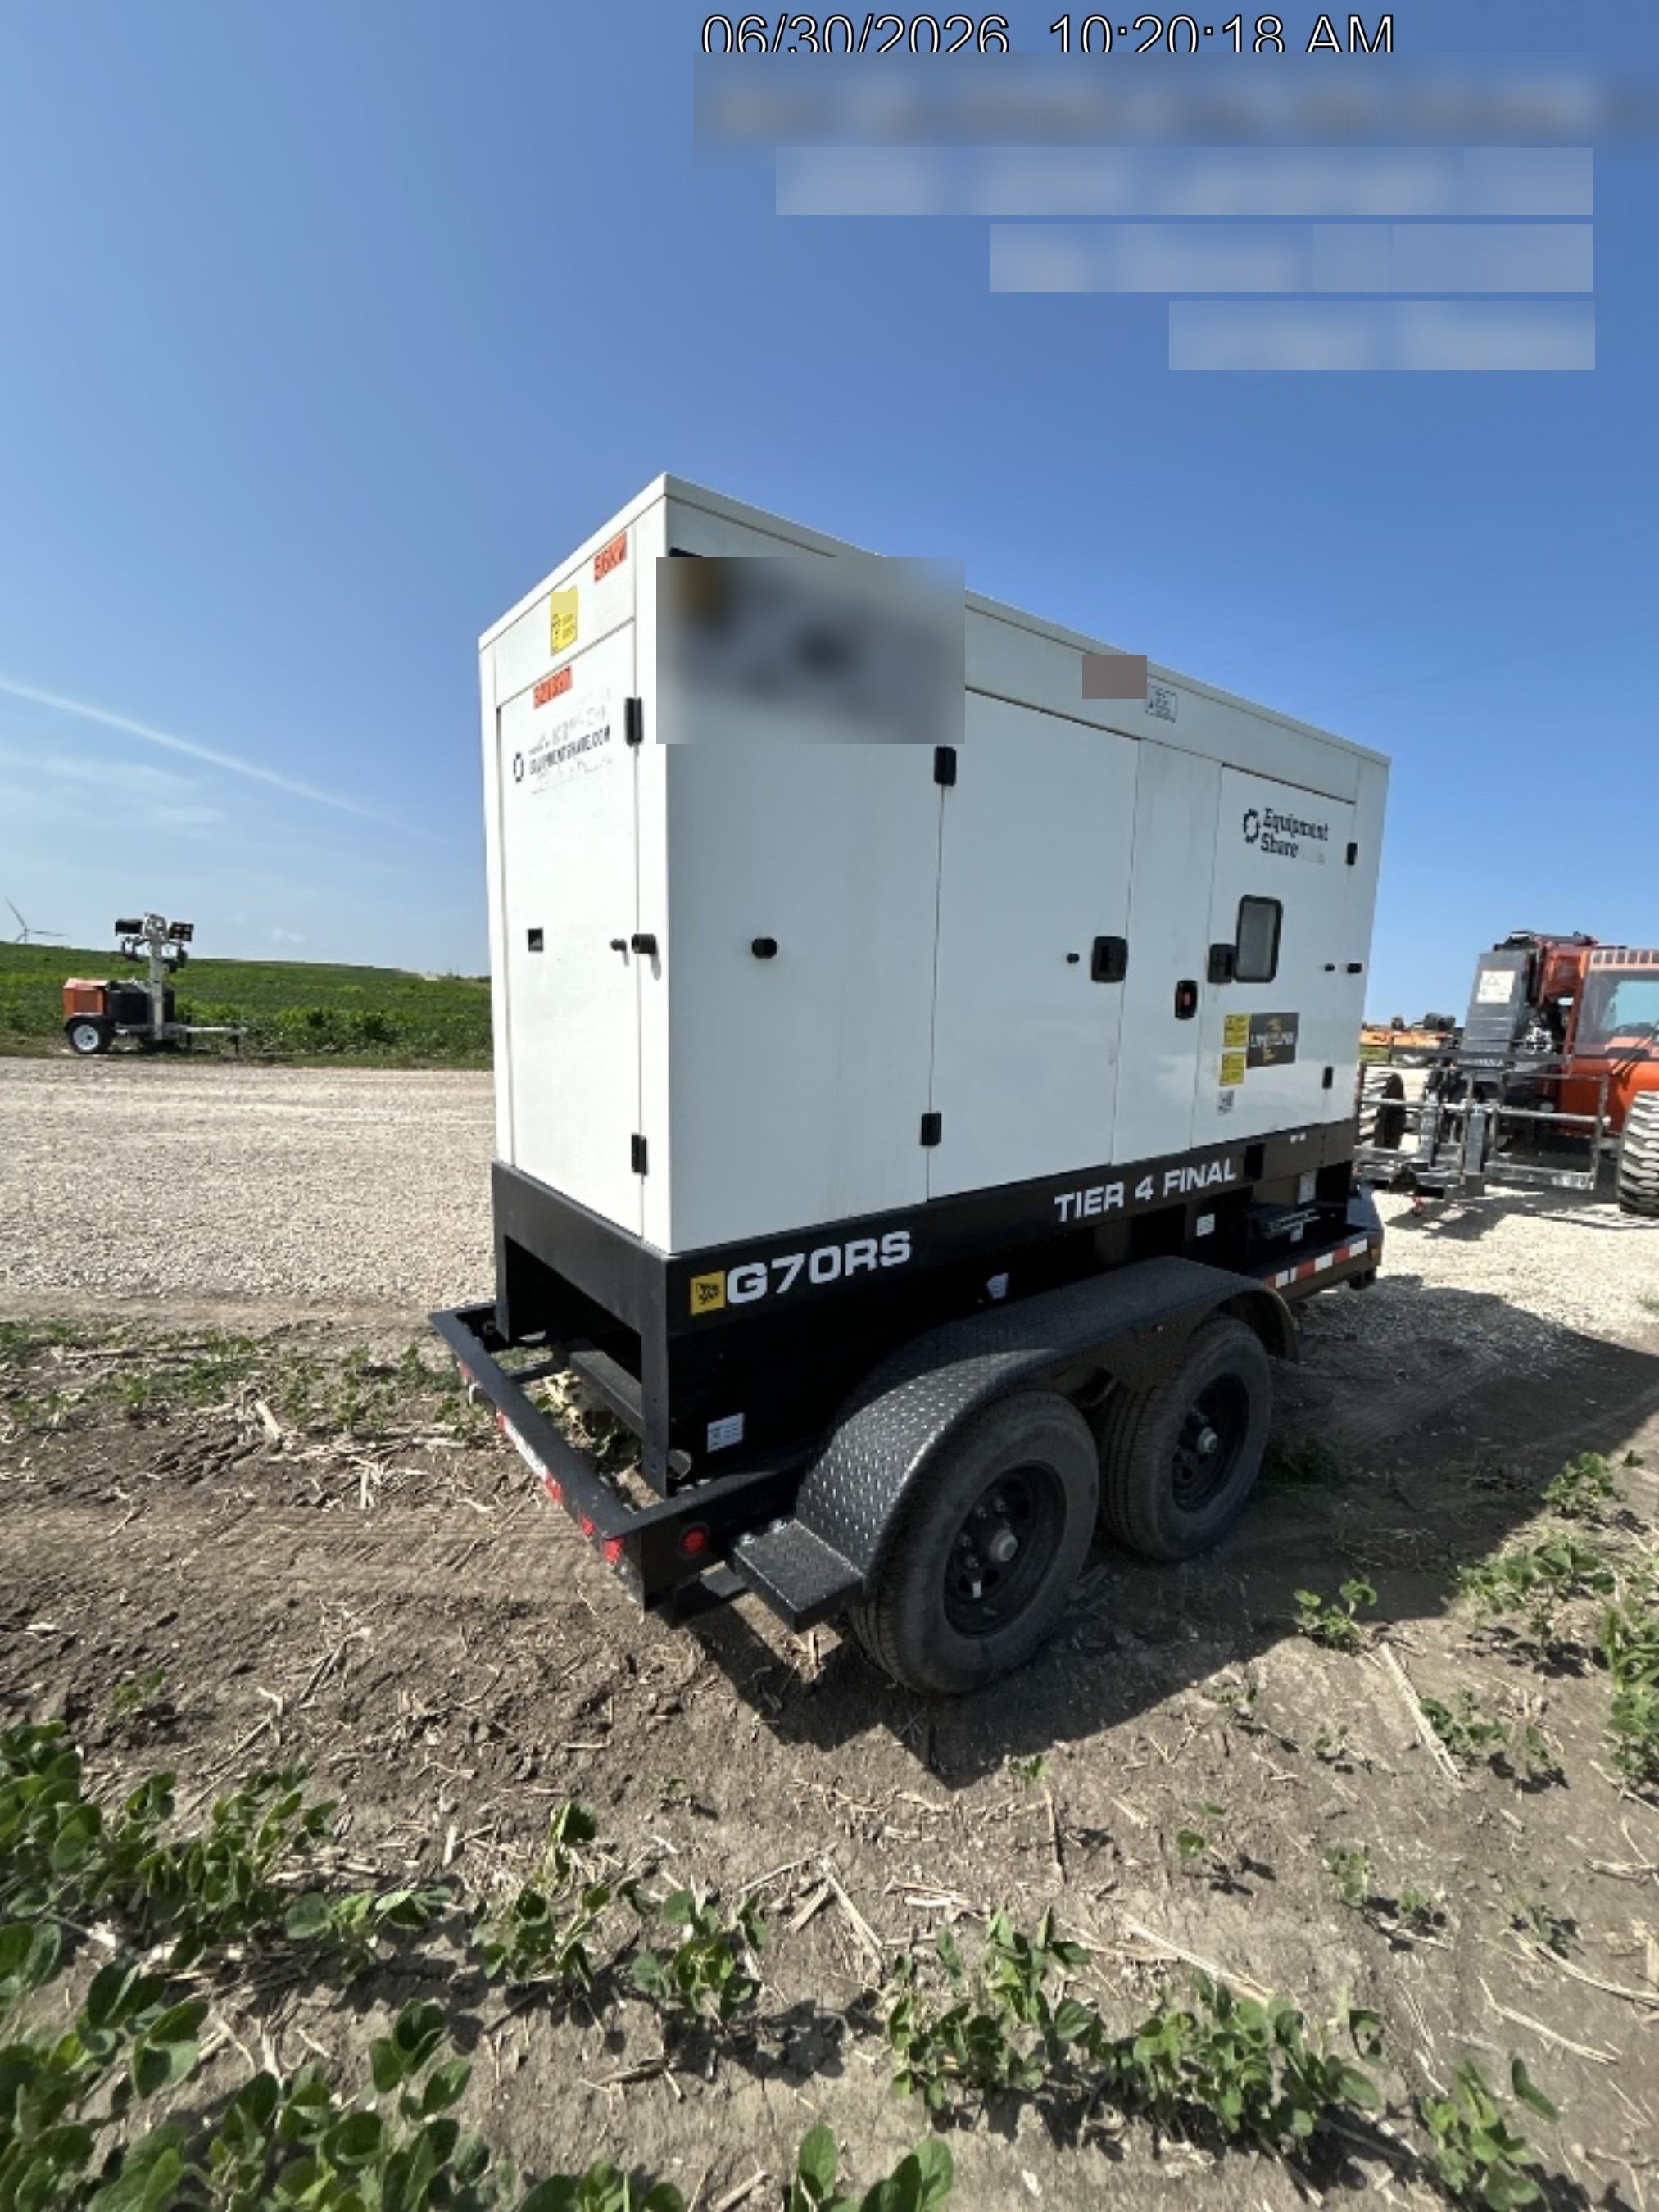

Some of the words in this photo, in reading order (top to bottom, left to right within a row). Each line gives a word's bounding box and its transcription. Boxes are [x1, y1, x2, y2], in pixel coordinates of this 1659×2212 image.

[1261, 832, 1299, 858] Share
[1263, 807, 1328, 841] Equipment
[1054, 1181, 1124, 1222] TIER
[1135, 1174, 1154, 1200] 4
[1163, 1157, 1236, 1198] FINAL
[727, 1230, 911, 1304] G70RS
